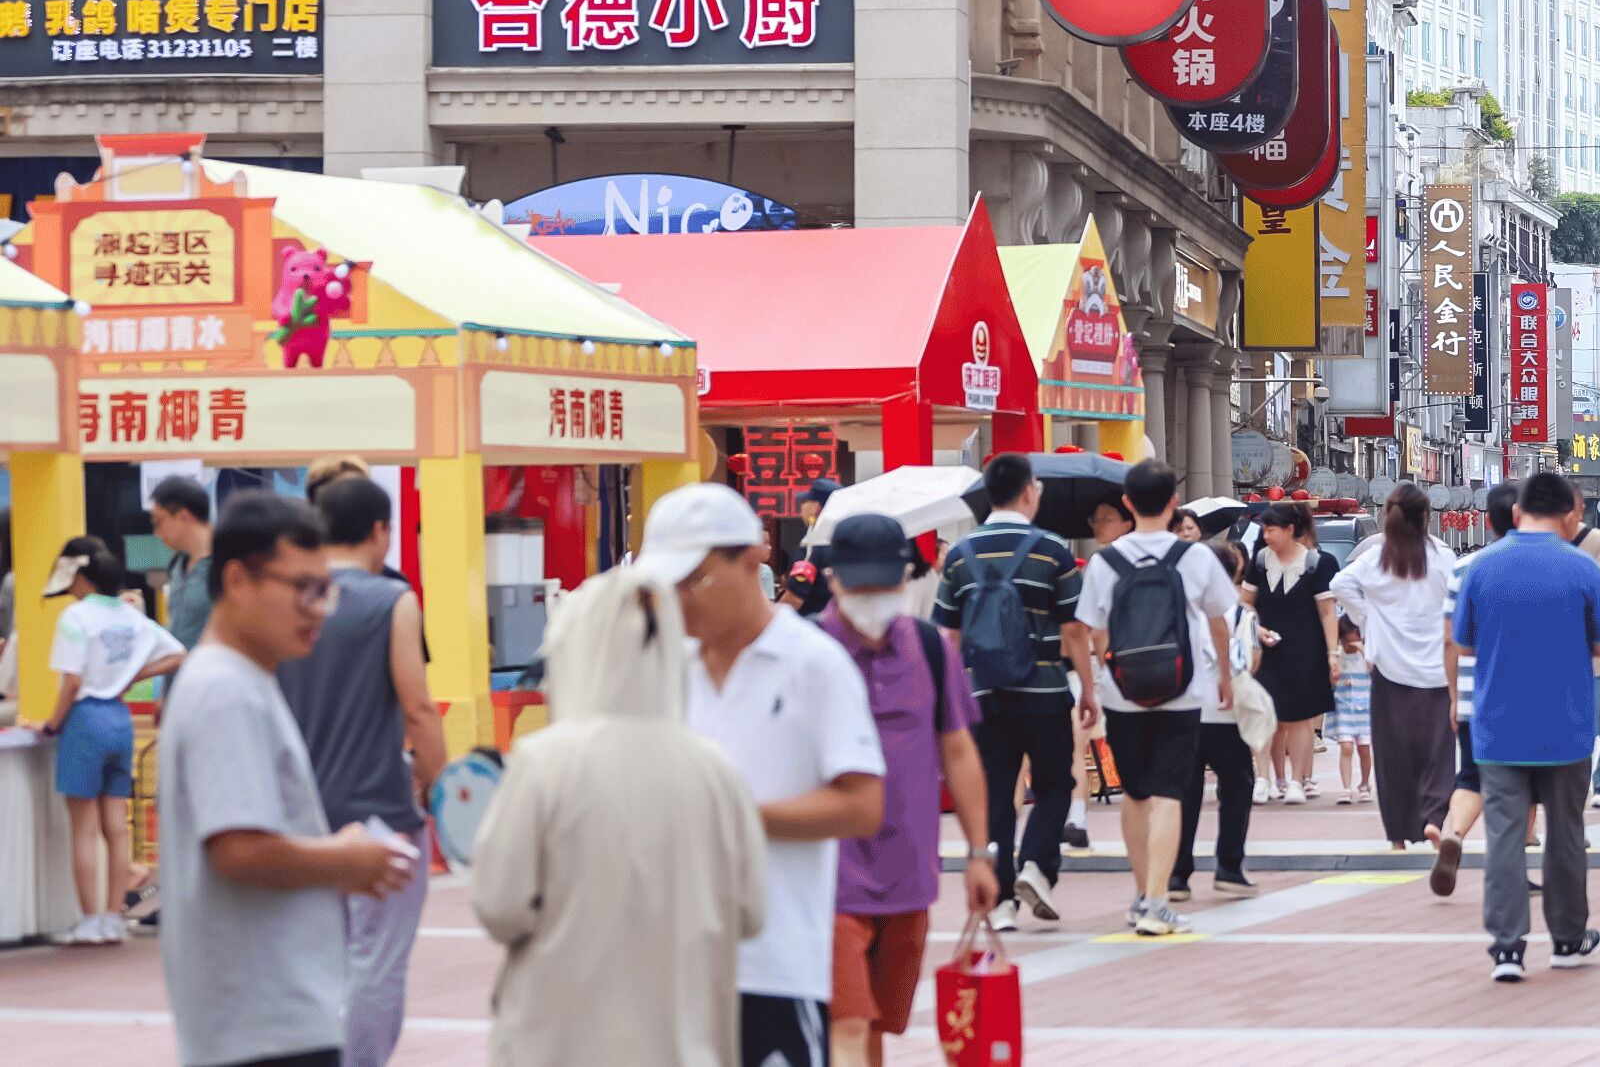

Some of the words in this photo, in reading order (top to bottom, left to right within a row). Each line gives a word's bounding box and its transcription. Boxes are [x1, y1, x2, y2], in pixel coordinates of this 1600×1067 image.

[1187, 111, 1266, 134] 本座4楼
[1429, 239, 1467, 356] 人民金行
[1520, 314, 1539, 420] 联合大众眼镜
[548, 387, 624, 441] 海南椰青
